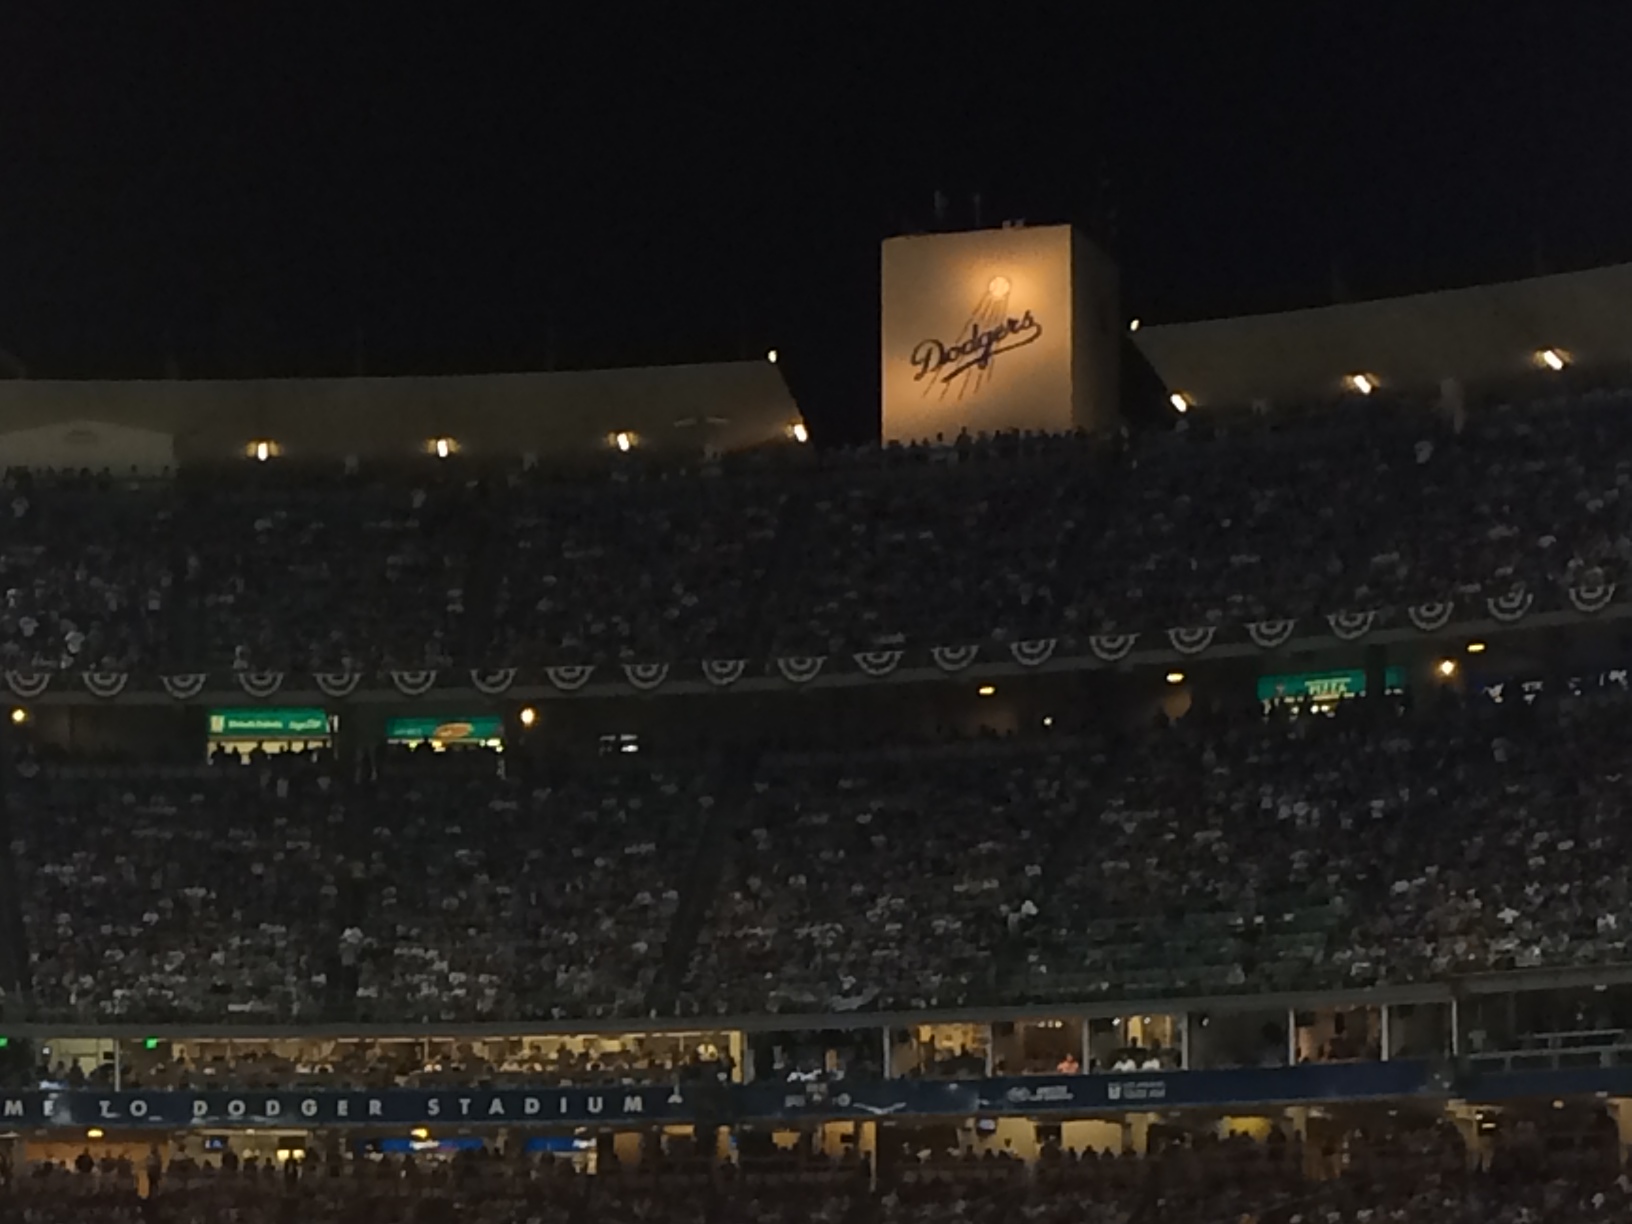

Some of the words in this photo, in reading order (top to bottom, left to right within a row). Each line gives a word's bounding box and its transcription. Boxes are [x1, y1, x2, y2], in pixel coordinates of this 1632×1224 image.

[911, 309, 1042, 383] Dodgers
[99, 1099, 148, 1117] TO
[192, 1099, 384, 1117] DODGER
[427, 1096, 644, 1116] STADIUM
